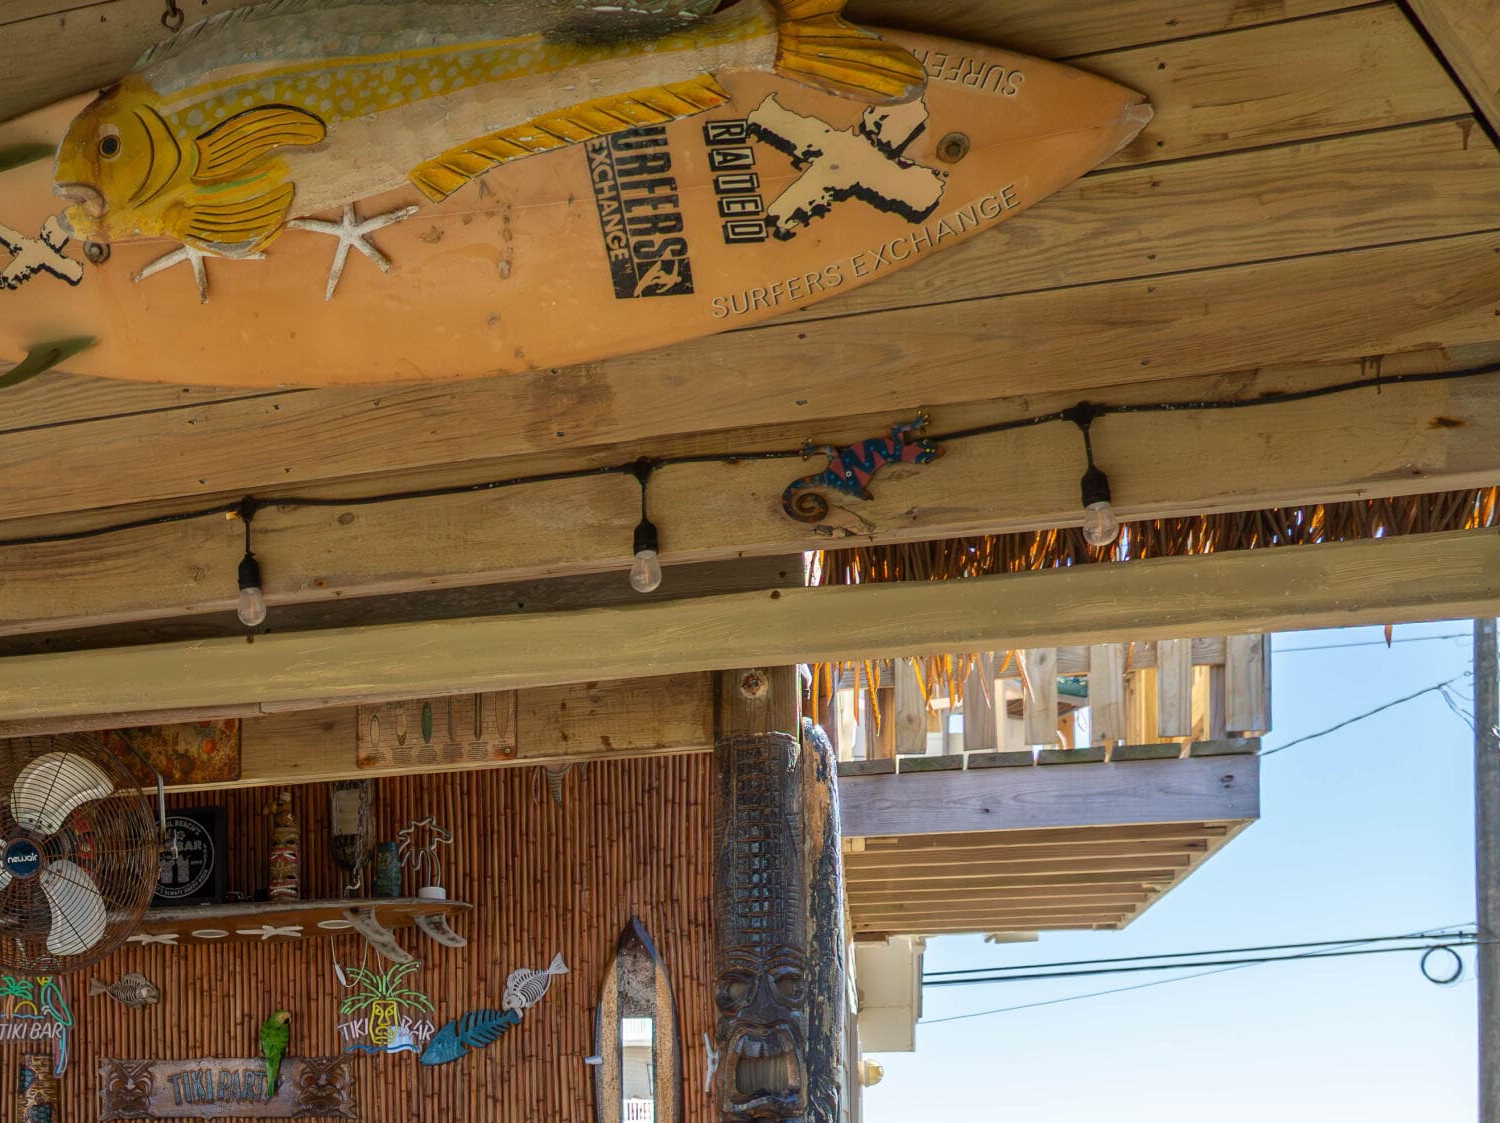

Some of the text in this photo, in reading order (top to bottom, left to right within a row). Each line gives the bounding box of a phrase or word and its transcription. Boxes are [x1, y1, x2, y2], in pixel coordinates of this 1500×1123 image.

[589, 138, 631, 263] EXCHANGE
[610, 126, 689, 260] URFERS
[703, 119, 768, 244] RATED
[711, 183, 1021, 318] SURFERS EXCHANGE
[7, 852, 38, 863] newair
[0, 1022, 63, 1040] TIKI BAR
[338, 1015, 436, 1041] TIKI BAR
[167, 1068, 284, 1105] TIKI PART
